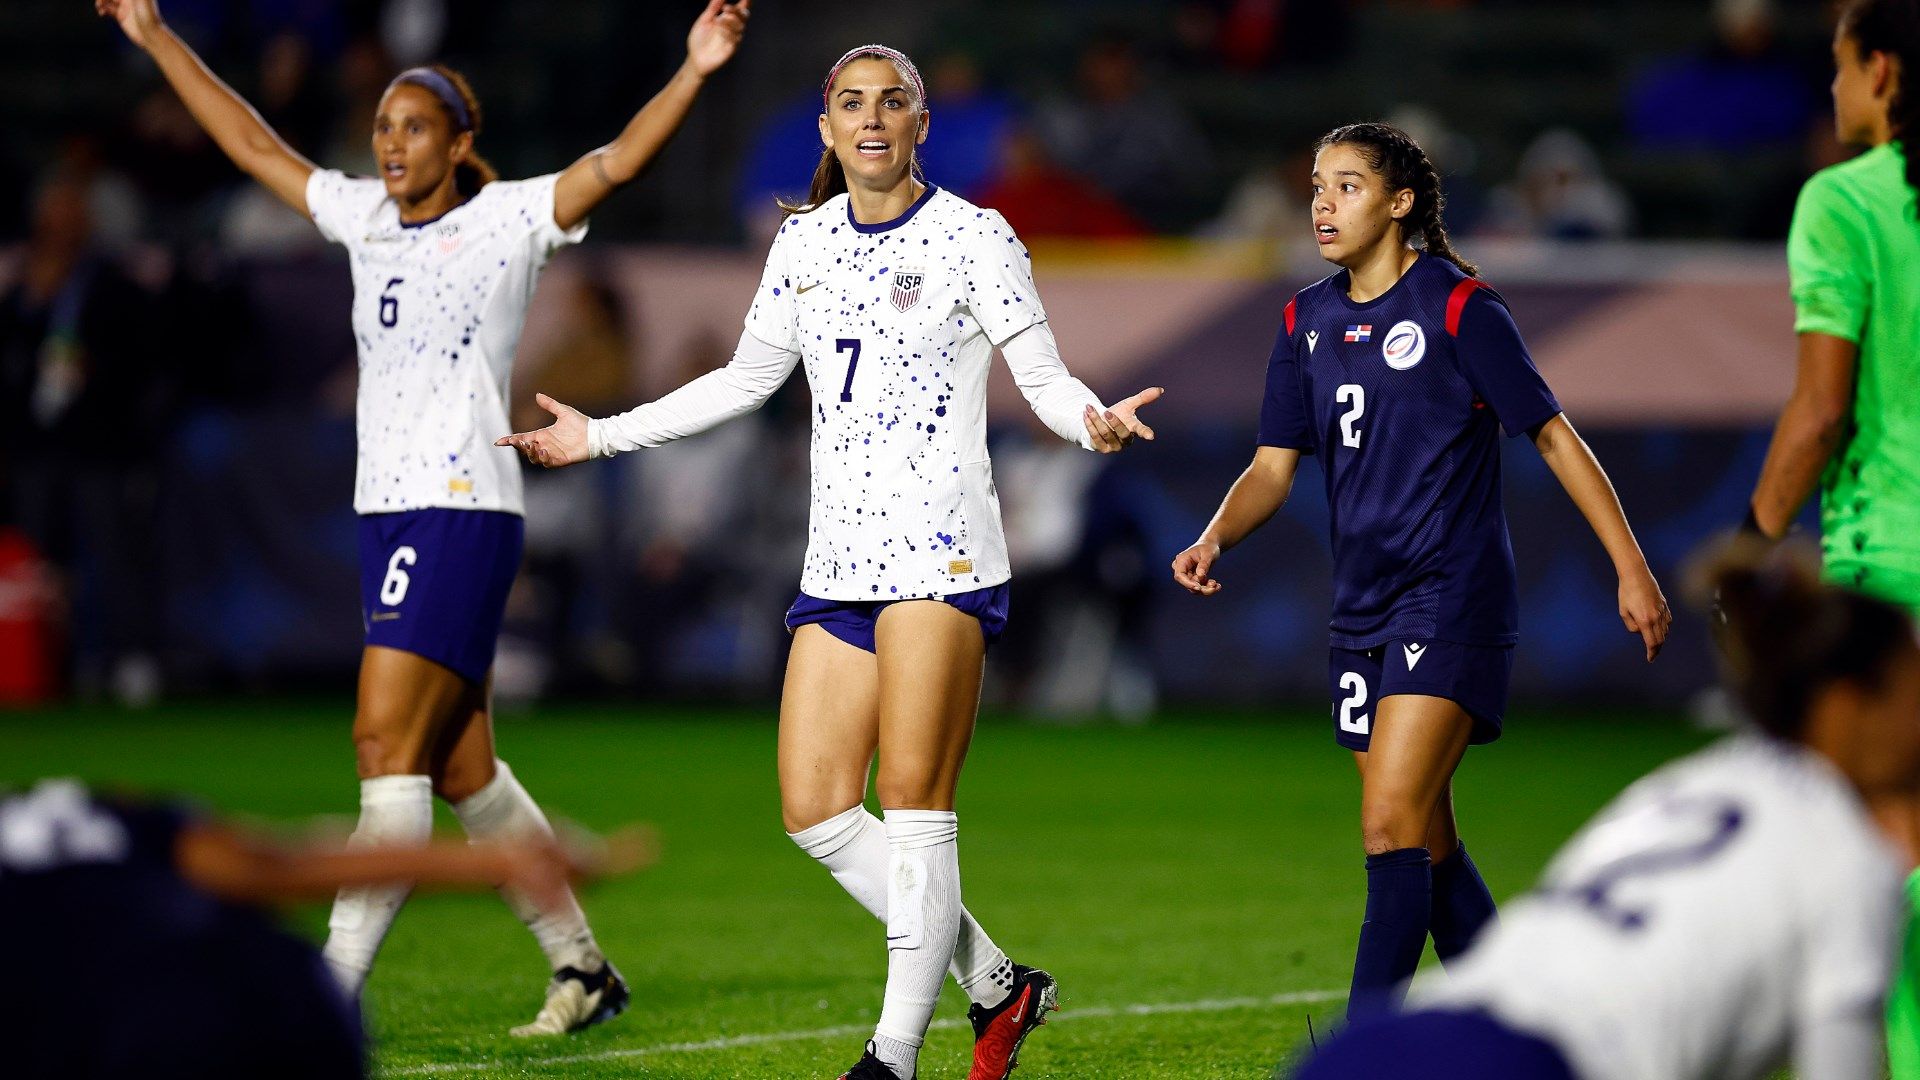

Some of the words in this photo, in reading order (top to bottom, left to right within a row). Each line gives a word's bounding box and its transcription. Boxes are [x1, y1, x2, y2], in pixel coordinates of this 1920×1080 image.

[379, 278, 404, 328] 6
[896, 275, 922, 290] USA
[835, 338, 862, 403] 7
[1335, 384, 1365, 448] 2
[380, 545, 417, 606] 6
[1339, 671, 1369, 735] 2
